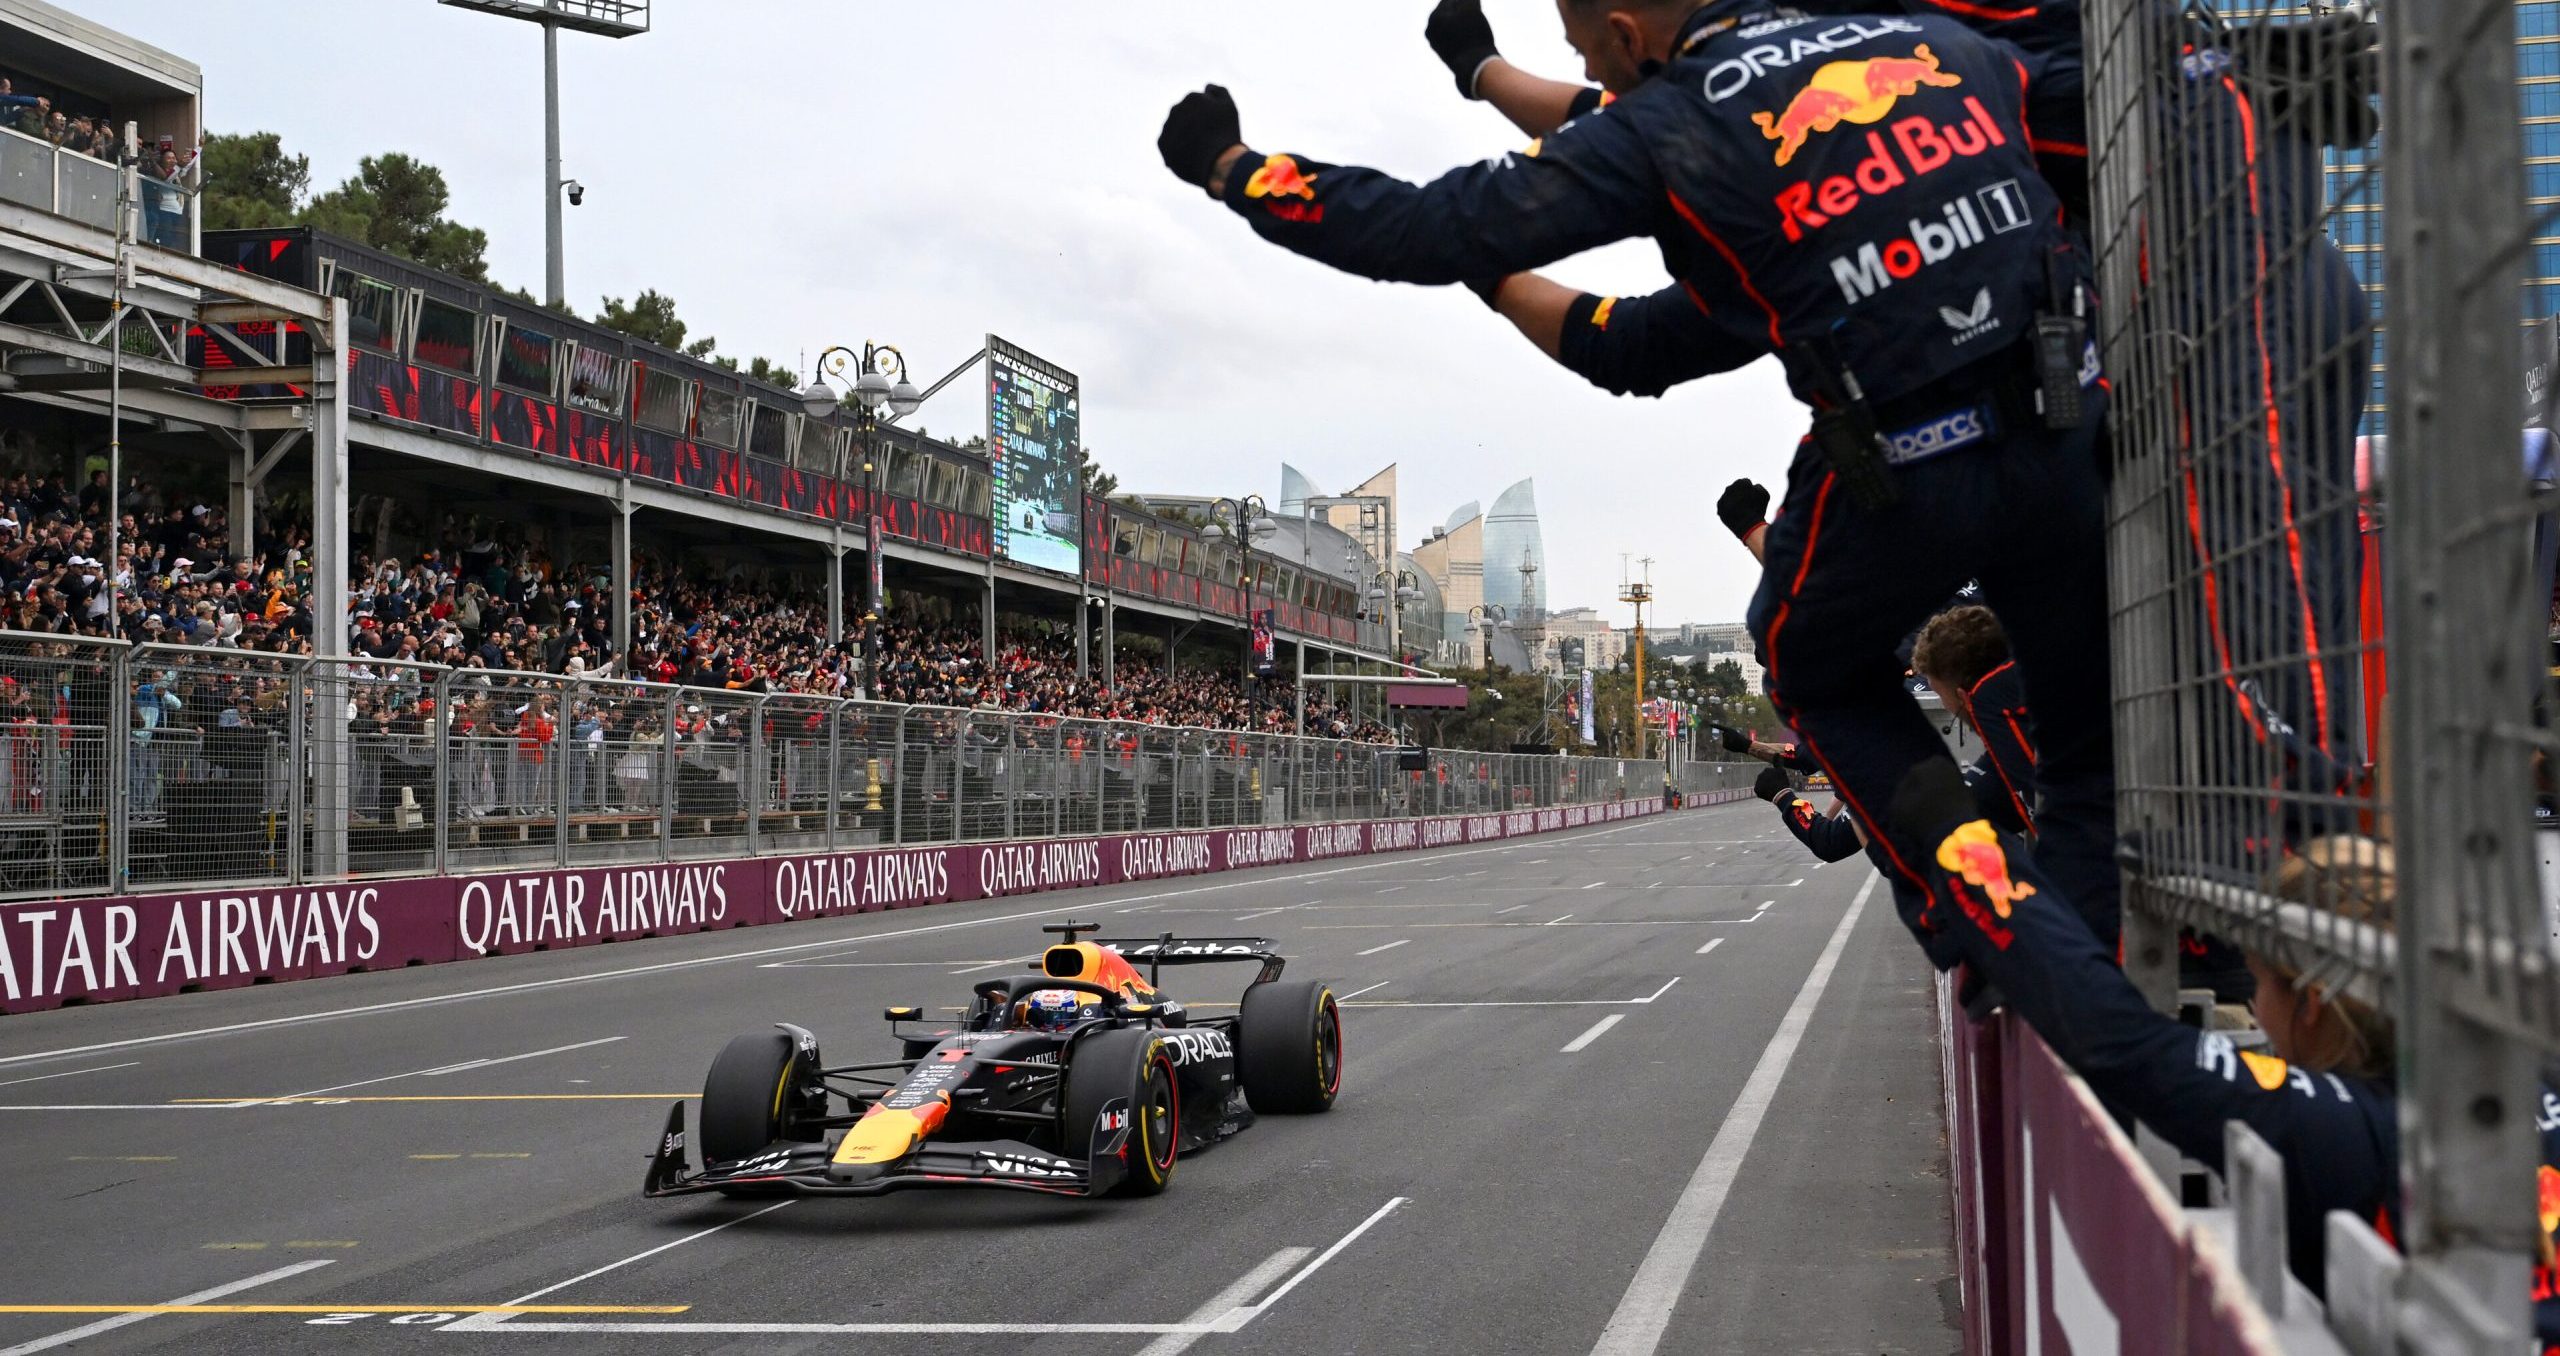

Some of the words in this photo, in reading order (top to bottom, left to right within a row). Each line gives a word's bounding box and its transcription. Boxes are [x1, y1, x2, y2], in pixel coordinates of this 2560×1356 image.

[1704, 18, 1922, 102] ORACLE
[1773, 131, 1905, 243] Red
[1829, 197, 1985, 305] Mobil
[981, 845, 1036, 896] QATAR
[1039, 840, 1099, 885] AIRWAYS
[1122, 836, 1162, 879] QATAR
[1165, 834, 1210, 871] AIRWAYS
[1226, 830, 1258, 869] QATAR
[1259, 828, 1295, 862] AIRWAYS
[1307, 826, 1333, 858] QATAR
[1333, 824, 1362, 853] AIRWAYS
[459, 876, 587, 955] QATAR
[596, 866, 726, 934] AIRWAYS
[776, 857, 857, 918] QATAR
[862, 851, 948, 905] AIRWAYS
[157, 888, 380, 983] AIRWAYS
[1025, 1050, 1057, 1065] CARLYLE
[1101, 1108, 1129, 1131] Mobil
[979, 1150, 1079, 1177] VISA
